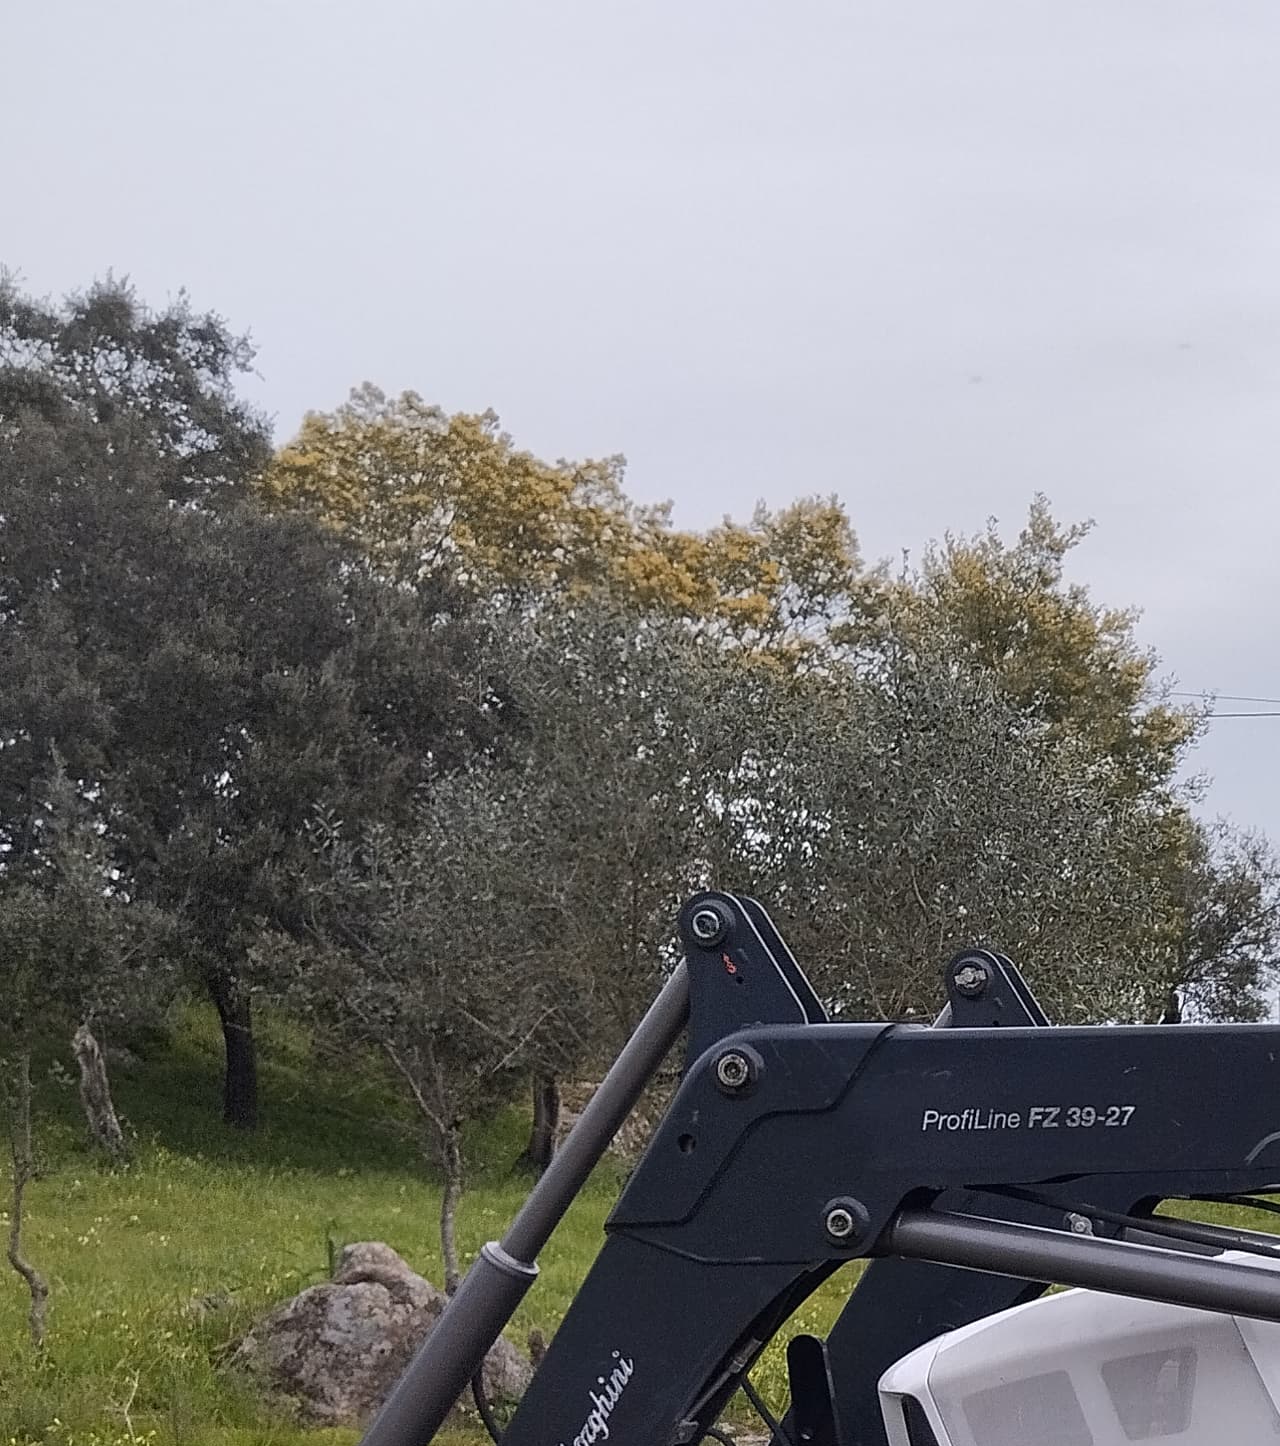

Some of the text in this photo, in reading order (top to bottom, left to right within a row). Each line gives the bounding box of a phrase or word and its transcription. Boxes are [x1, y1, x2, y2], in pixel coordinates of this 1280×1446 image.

[921, 1106, 1136, 1131] ProfiLine FZ 39-27
